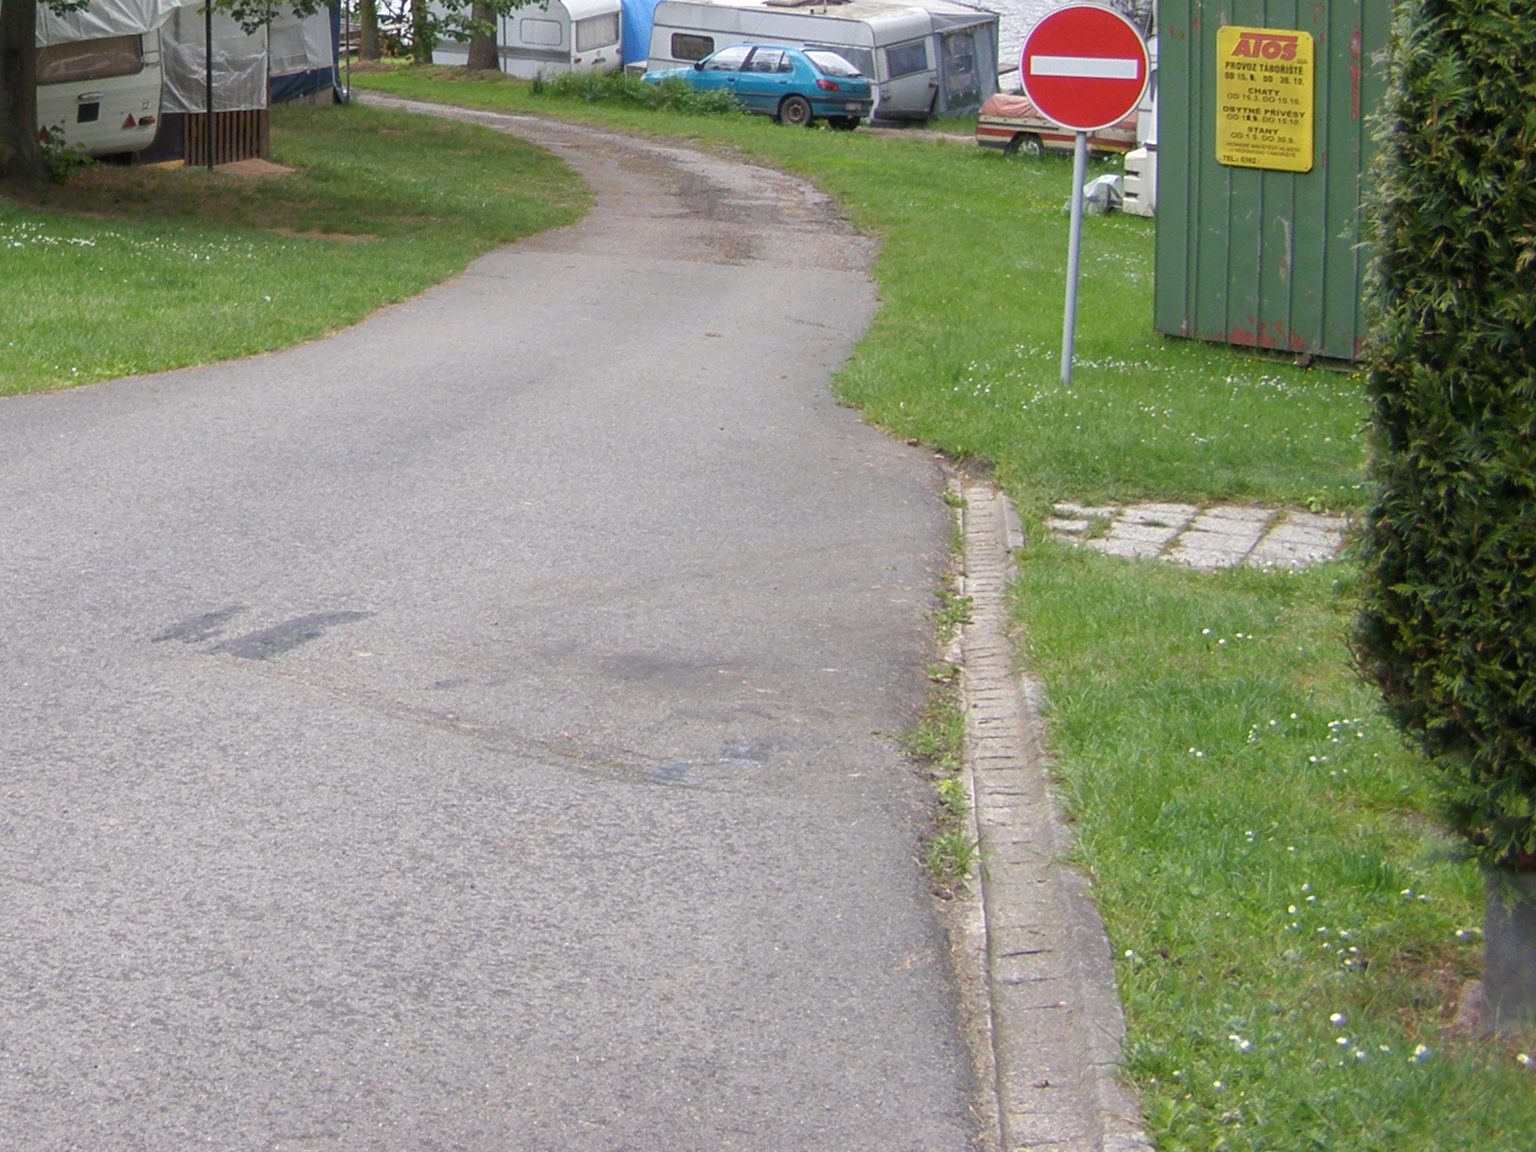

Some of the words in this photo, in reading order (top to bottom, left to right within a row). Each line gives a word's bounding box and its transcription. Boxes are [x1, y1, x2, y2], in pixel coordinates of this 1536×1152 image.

[1232, 32, 1299, 61] ATOS
[1225, 61, 1257, 72] PROVOZ
[1225, 71, 1234, 80] OD
[1263, 75, 1274, 84] DO
[1249, 88, 1280, 96] CHATY
[1223, 105, 1261, 115] OBYTNÉ
[1247, 126, 1279, 135] STANY
